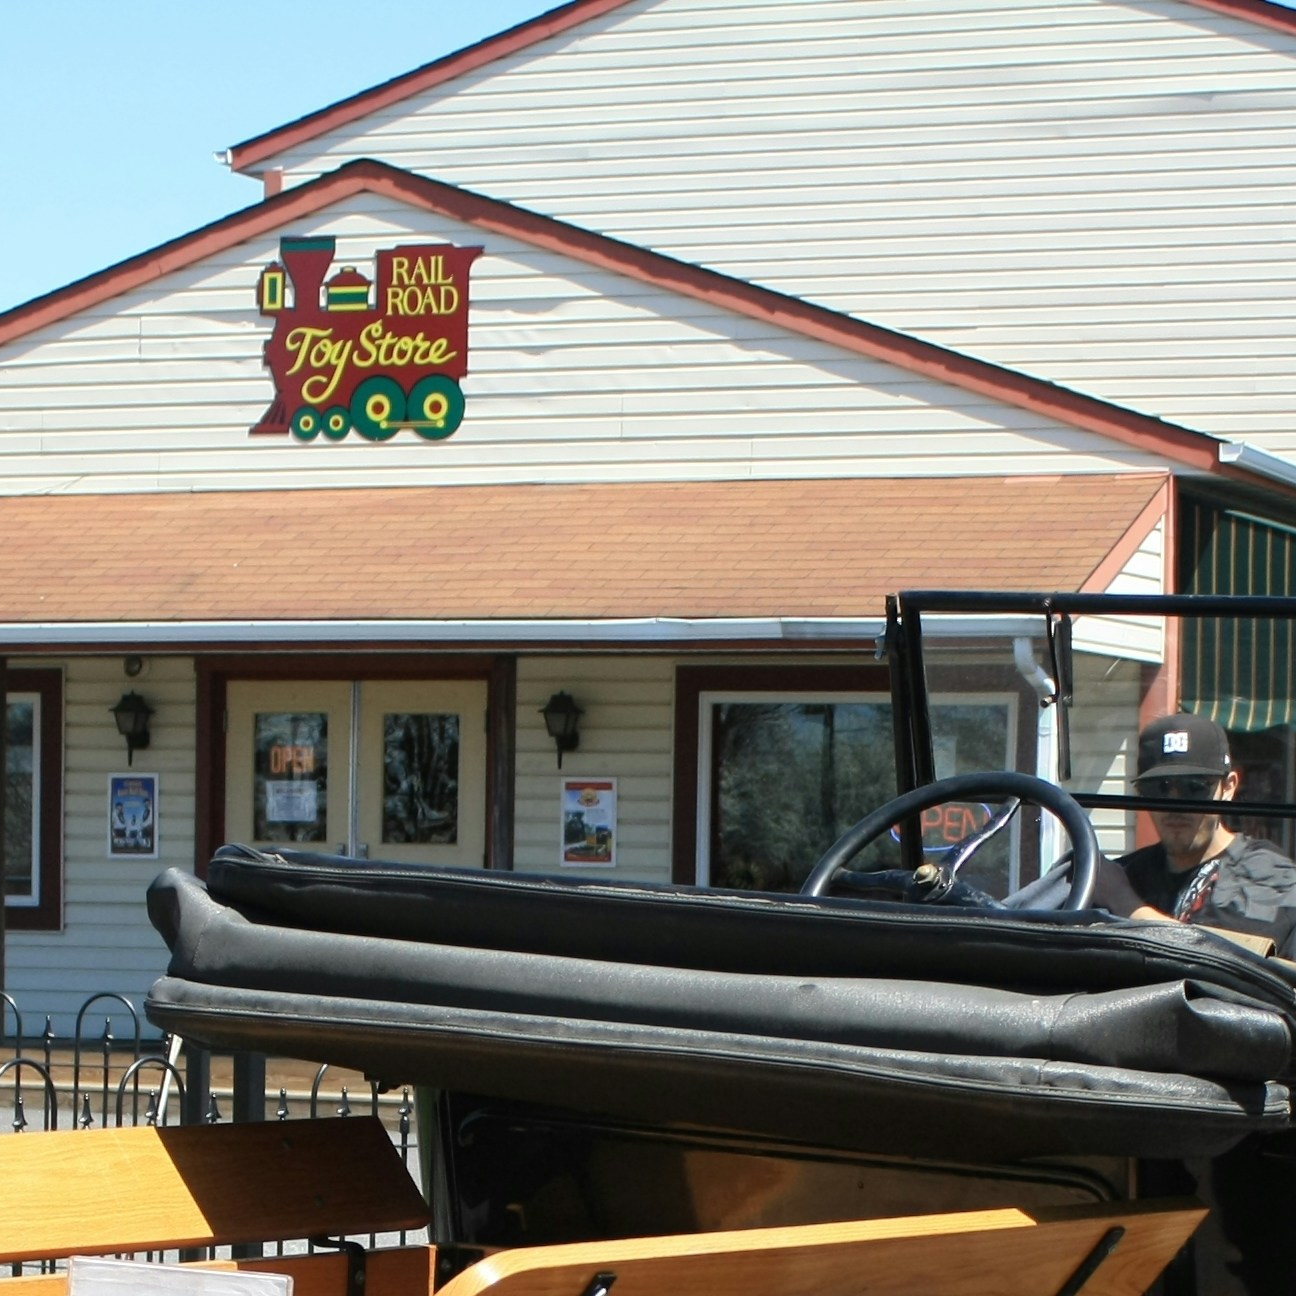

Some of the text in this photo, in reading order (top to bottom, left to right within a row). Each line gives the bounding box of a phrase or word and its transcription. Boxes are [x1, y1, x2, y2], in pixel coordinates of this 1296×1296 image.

[392, 255, 454, 285] RAIL
[386, 287, 459, 316] ROAD
[285, 319, 458, 404] Toy Store
[271, 746, 315, 774] OPEN
